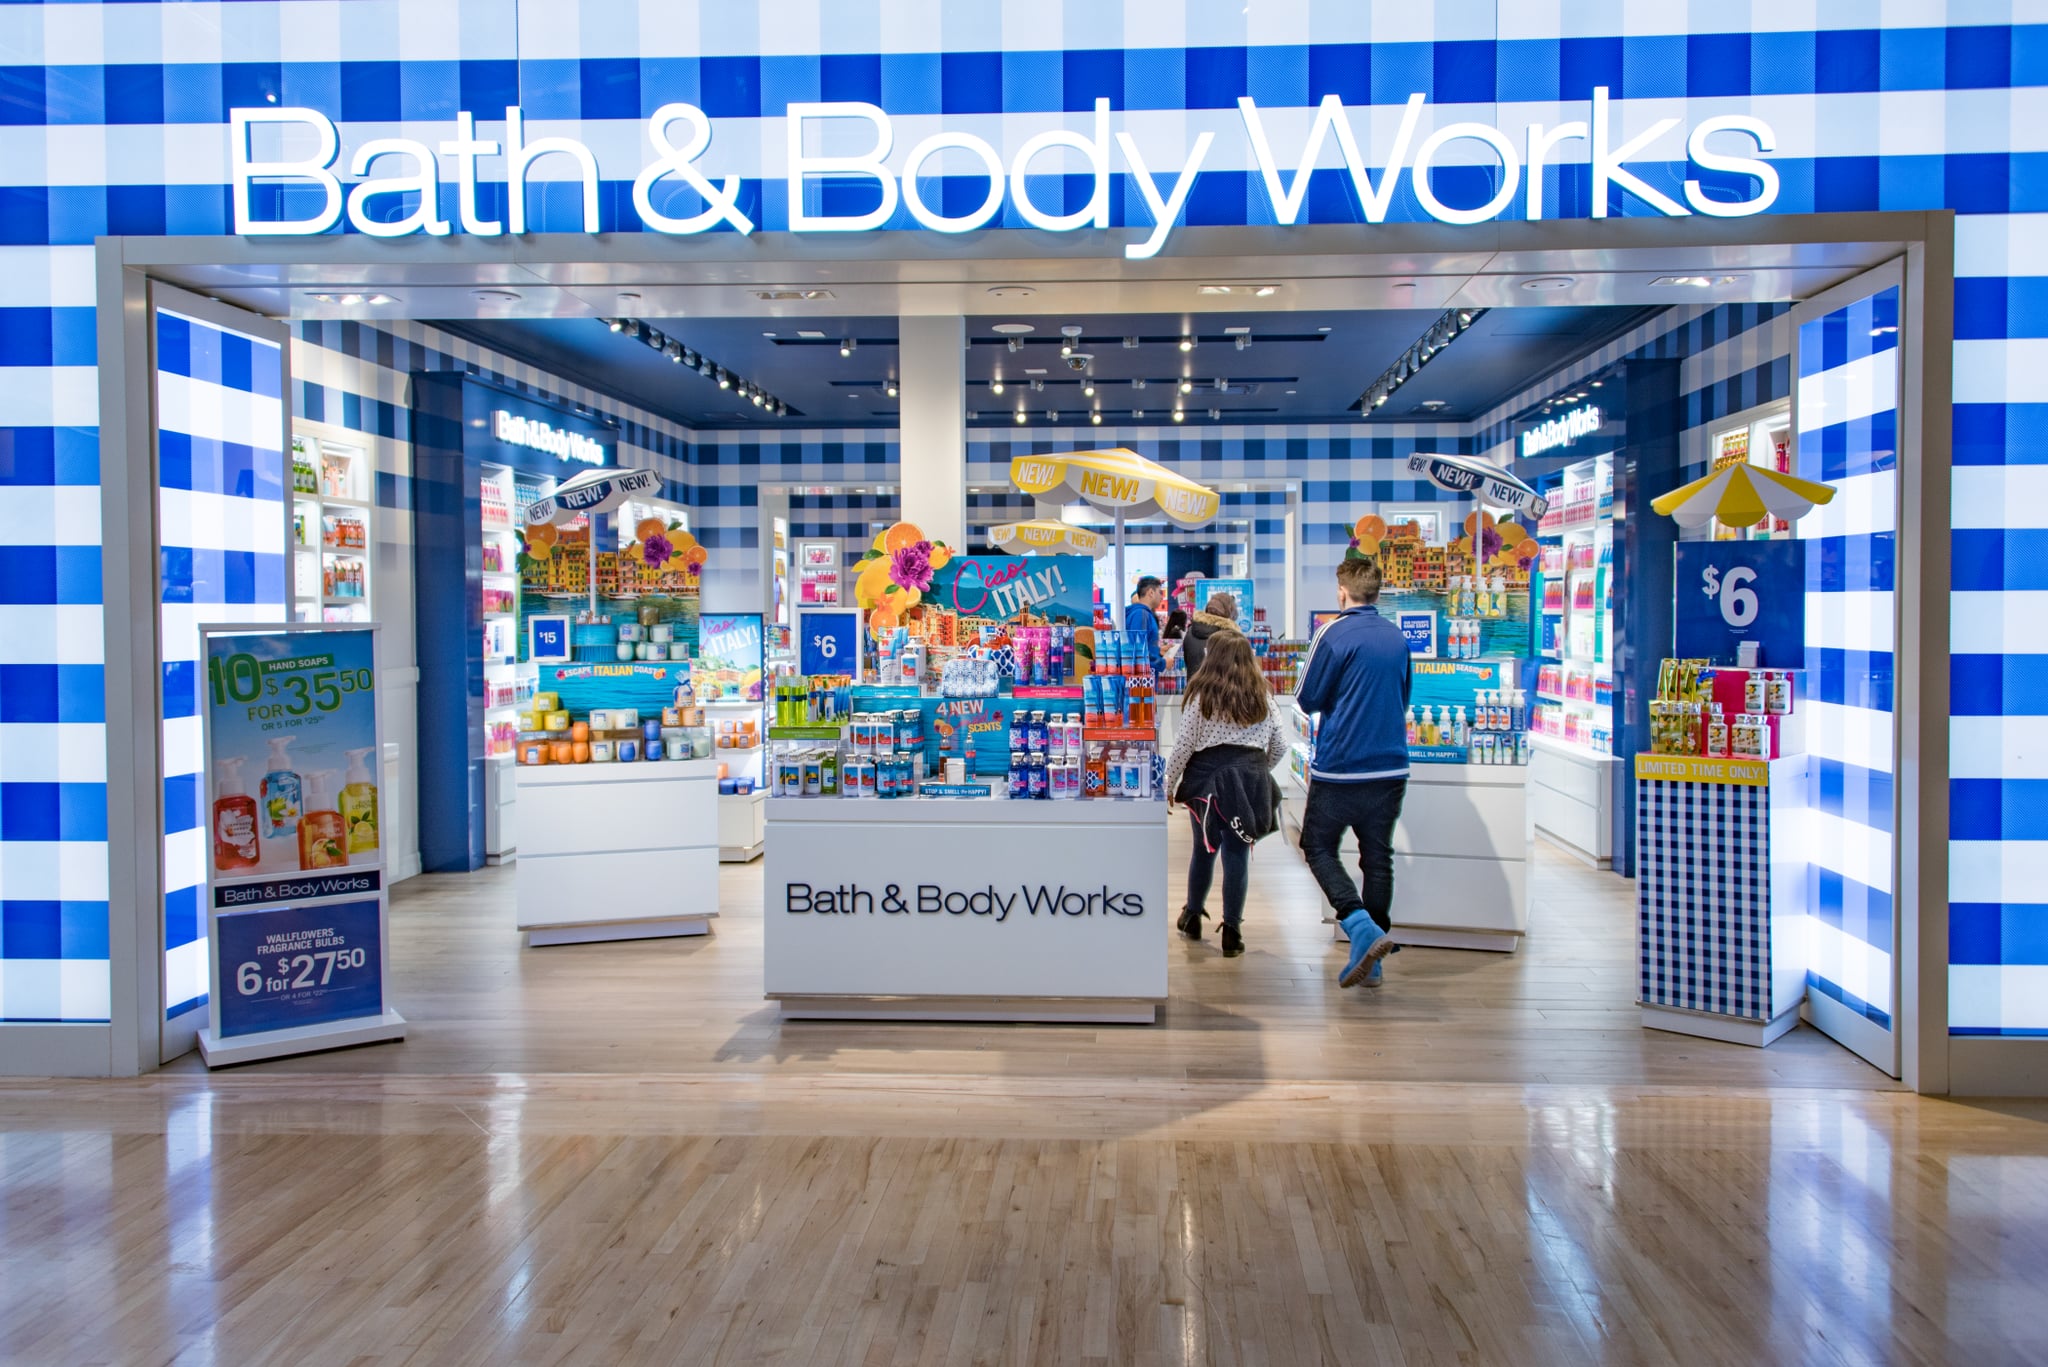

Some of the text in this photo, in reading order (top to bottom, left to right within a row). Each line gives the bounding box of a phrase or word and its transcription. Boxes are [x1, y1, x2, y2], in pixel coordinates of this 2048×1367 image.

[230, 86, 1780, 260] Bath & Body Works
[1017, 462, 1056, 486] NEW!
[1408, 456, 1427, 472] NEW!
[618, 474, 650, 492] NEW!
[1080, 470, 1139, 502] NEW!
[1436, 464, 1475, 490] NEW!
[564, 484, 604, 508] NEW!
[1164, 486, 1207, 518] NEW!
[1490, 482, 1524, 506] NEW!
[529, 502, 552, 522] NEW!
[1023, 527, 1056, 542] NEW!
[1072, 533, 1097, 548] NEW!
[992, 565, 1068, 617] ITALY!
[1702, 564, 1759, 627] $6
[538, 631, 556, 644] $15
[710, 624, 760, 656] ITALY!
[814, 634, 837, 658] $6
[268, 656, 328, 672] HAND SOAPS
[593, 664, 634, 676] ITALIAN
[1414, 662, 1456, 674] ITALIAN
[209, 652, 262, 706] 10
[248, 704, 284, 721] FOR
[936, 699, 984, 716] 4 NEW
[262, 722, 274, 731] OR
[285, 718, 302, 728] FOR
[968, 721, 1002, 733] SCENTS
[1638, 760, 1764, 780] LIMITED TIME ONLY!
[224, 878, 370, 903] Bath & Body Works
[786, 882, 1144, 922] Bath & Body Works
[257, 936, 344, 955] FRAGRANCE BULBS
[236, 961, 262, 996] 6
[266, 977, 289, 993] for
